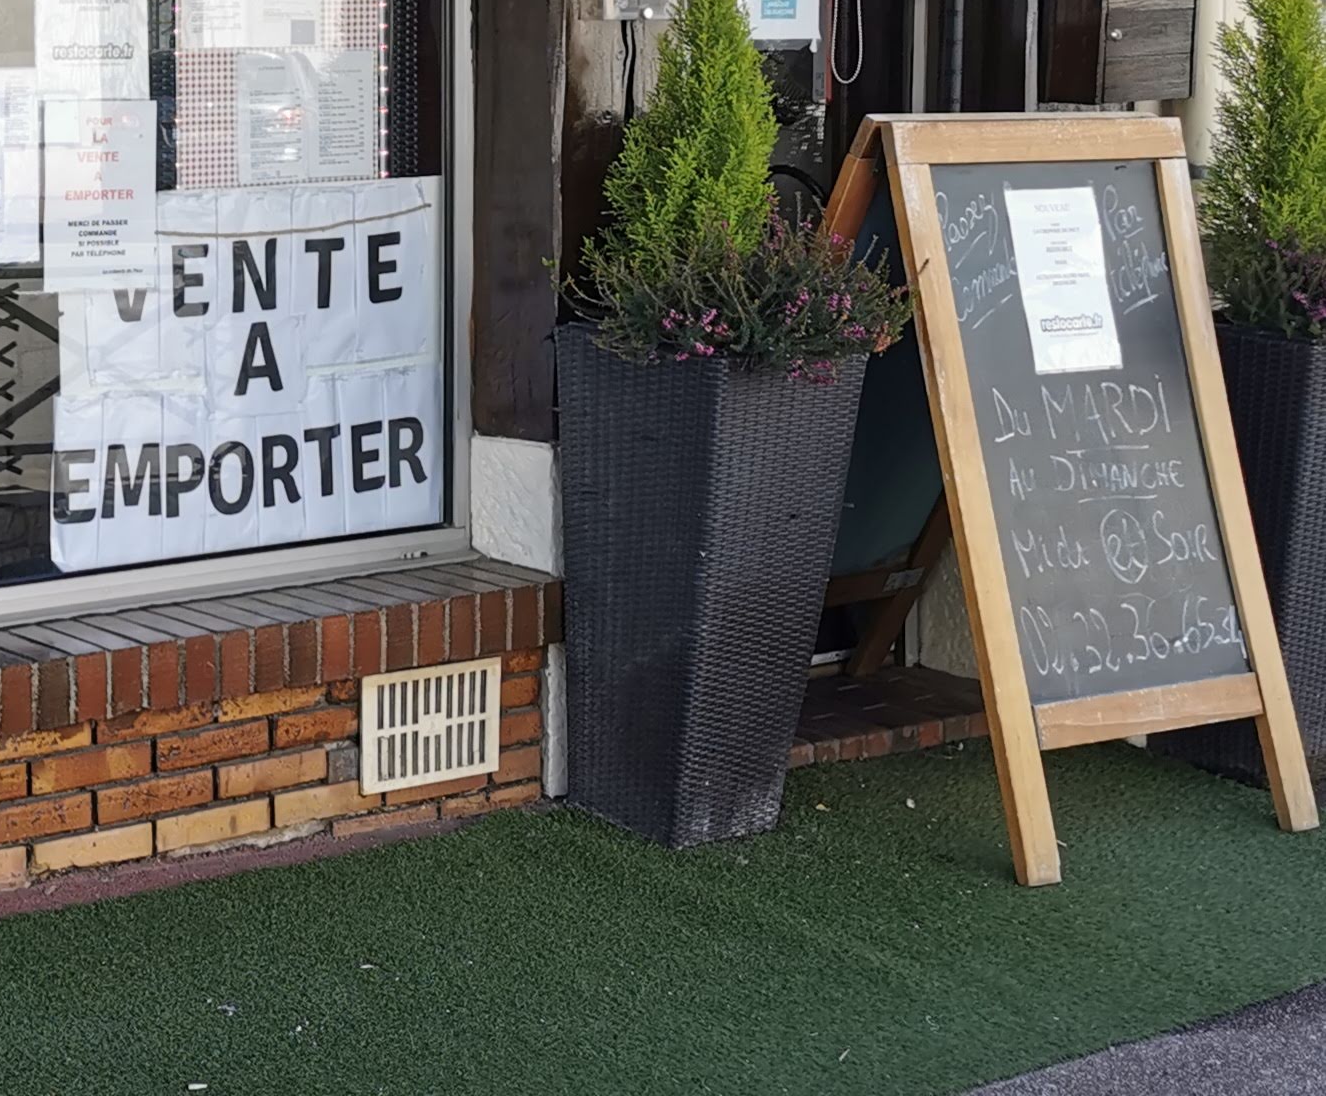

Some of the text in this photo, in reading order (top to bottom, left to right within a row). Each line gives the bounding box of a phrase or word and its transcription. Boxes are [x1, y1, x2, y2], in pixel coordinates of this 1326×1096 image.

[86, 117, 113, 127] POUR
[77, 151, 119, 163] VENTE
[94, 171, 103, 181] A
[65, 189, 134, 201] EMPORTER
[234, 321, 283, 396] A
[52, 416, 427, 524] EMPORTER
